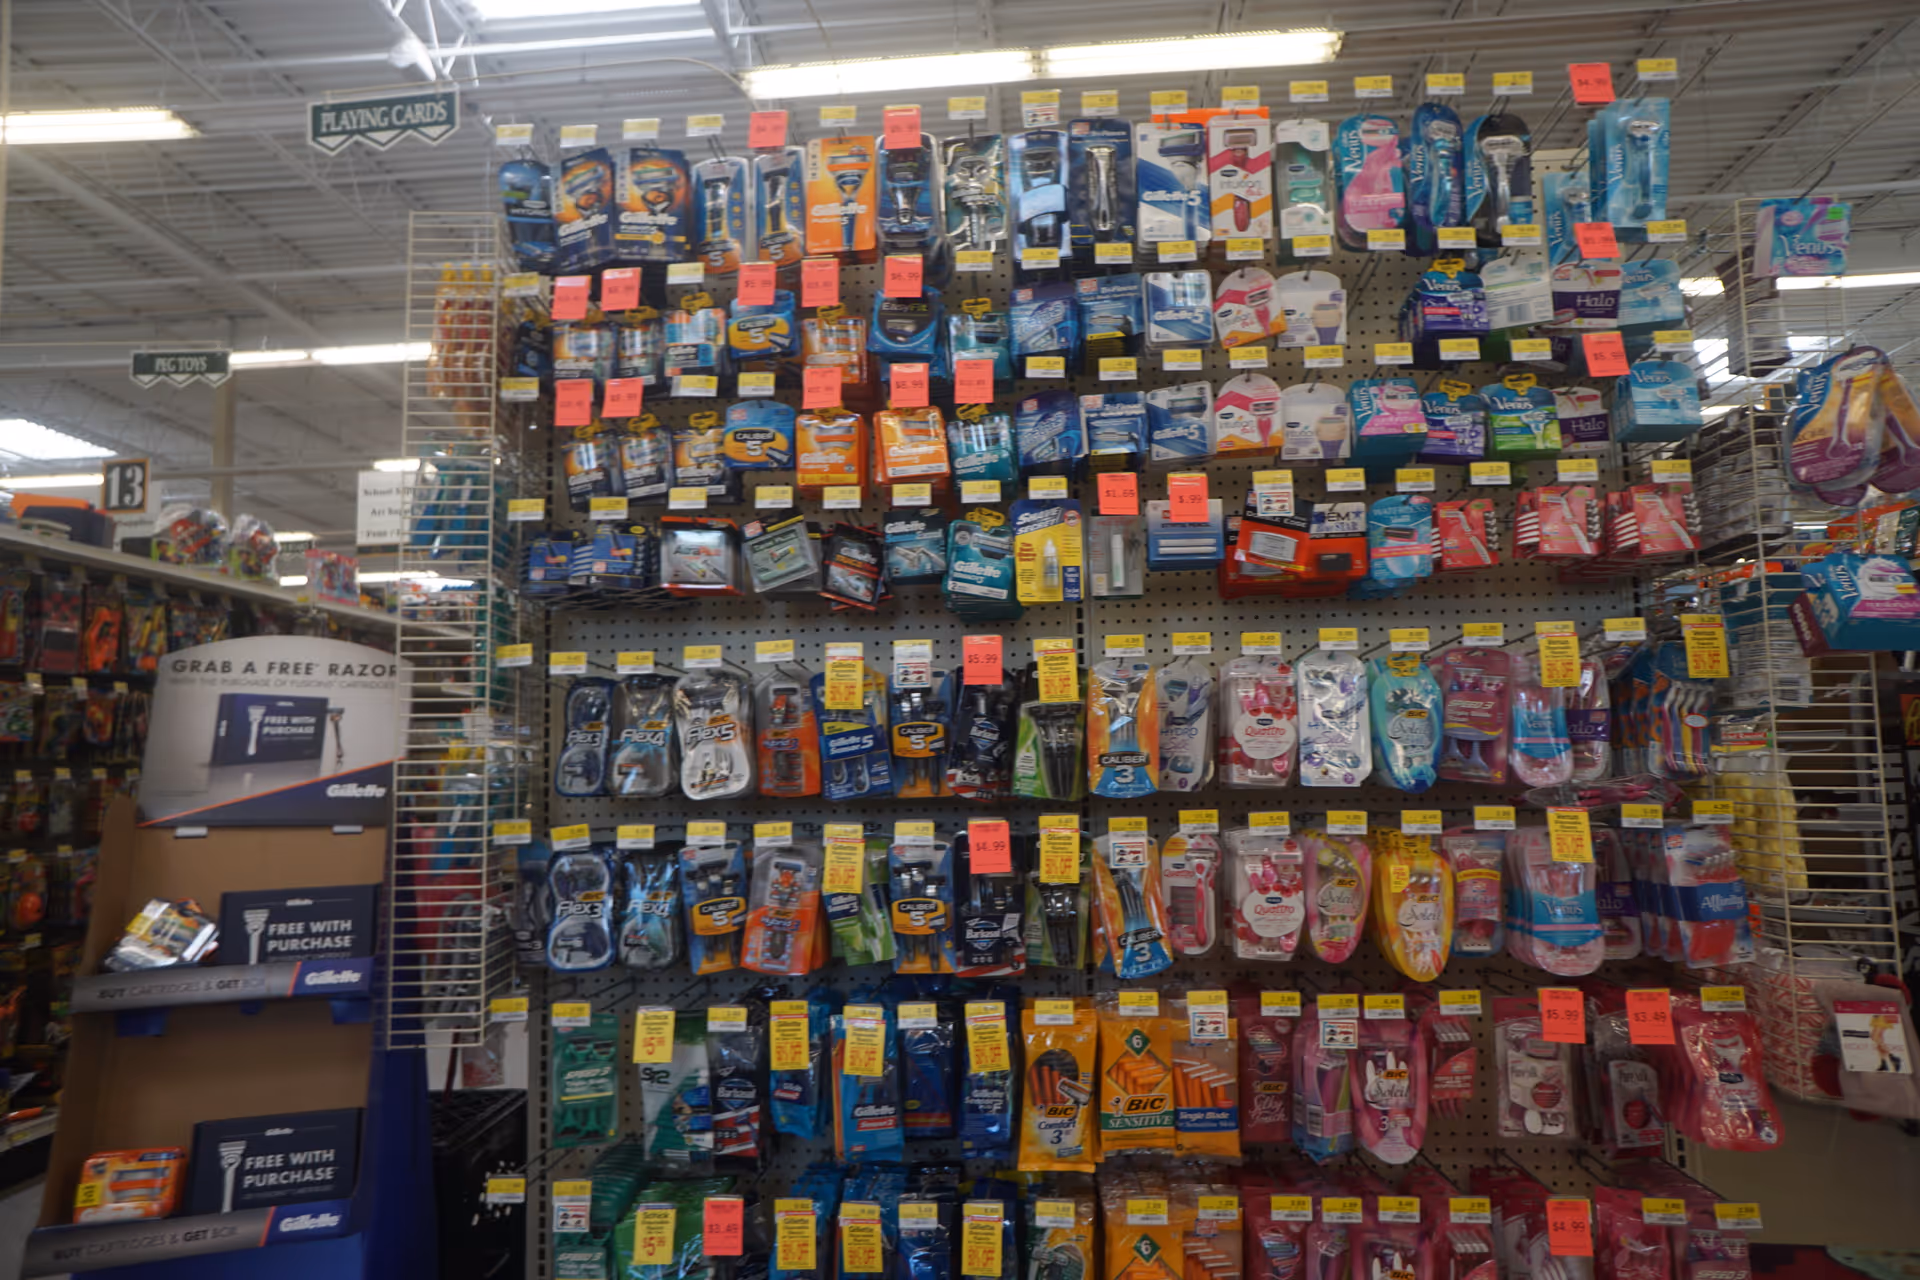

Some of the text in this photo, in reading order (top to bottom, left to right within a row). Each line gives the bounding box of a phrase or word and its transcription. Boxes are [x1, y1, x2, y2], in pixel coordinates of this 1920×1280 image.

[320, 101, 448, 133] PLAYING CARDS
[1344, 129, 1362, 173] Venus
[1411, 144, 1425, 183] Venus
[1608, 144, 1625, 184] Venus
[1467, 159, 1485, 200] Venus
[1142, 190, 1186, 202] Gillette
[811, 203, 868, 216] Gillette
[559, 213, 608, 235] Gillette
[619, 211, 678, 225] Gillette
[1780, 234, 1845, 257] Venus
[1424, 277, 1461, 291] Venus
[882, 301, 929, 313] EasyFit
[1576, 295, 1616, 307] Halo
[1154, 309, 1192, 321] Gillette
[155, 356, 207, 372] PEG TOYS
[1635, 369, 1672, 383] Venus
[1358, 386, 1373, 419] Venus
[1800, 373, 1829, 418] Venus
[1425, 400, 1461, 414] Venus
[1497, 396, 1533, 410] Venus
[1153, 426, 1187, 439] Gillette
[1571, 418, 1606, 433] Halo
[735, 431, 775, 440] CALIBER
[746, 440, 763, 456] 5
[889, 446, 935, 457] Gillette
[800, 453, 845, 464] Gillette
[954, 453, 999, 469] Gillette
[107, 464, 144, 509] 13
[885, 520, 926, 534] Gillette
[954, 560, 1001, 579] Gillette
[1836, 565, 1858, 600] Venus
[968, 654, 998, 665] $5.99
[172, 660, 232, 673] GRAB
[243, 661, 257, 674] A
[1448, 700, 1495, 709] SPEED 3
[264, 716, 316, 726] FREE WITH
[1405, 710, 1427, 718] BIC
[263, 724, 315, 735] PURCHASE
[687, 724, 736, 743] Flex5
[901, 725, 935, 735] CALIBER
[1160, 728, 1199, 738] HYDRO
[1245, 726, 1287, 738] Quattro
[567, 730, 601, 746] Flex3
[620, 729, 666, 746] Flex4
[829, 736, 860, 747] Gillette
[910, 735, 925, 750] 5
[1101, 754, 1146, 766] CALIBER
[1114, 765, 1136, 783] 3
[326, 784, 386, 799] Gillette
[1337, 879, 1357, 887] BIC
[1325, 891, 1354, 906] Soleil
[1417, 894, 1438, 902] BIC
[1701, 893, 1744, 911] Affinity
[556, 901, 604, 918] Flex3
[626, 900, 671, 918] Flex4
[702, 900, 738, 913] CALIBER
[900, 902, 935, 911] CALIBER
[1254, 904, 1295, 915] Quattro
[1545, 900, 1584, 915] Venus
[712, 911, 729, 926] 5
[910, 911, 926, 927] 5
[1404, 906, 1442, 922] Soleil
[268, 920, 353, 936] FREE WITH
[966, 929, 1001, 939] Barbasol
[266, 936, 354, 952] PURCHASE
[1118, 930, 1161, 948] CALIBER
[1135, 943, 1152, 960] 3
[304, 969, 362, 986] Gillette
[99, 986, 125, 998] BUY
[216, 979, 241, 990] GET
[1546, 1008, 1580, 1022] $5.99
[1132, 1036, 1143, 1048] 6
[565, 1067, 611, 1079] SPEED 3
[1385, 1070, 1407, 1079] BIC
[717, 1086, 756, 1099] Barbasol
[1262, 1082, 1285, 1092] BIC
[1373, 1080, 1410, 1099] Soleil
[854, 1104, 896, 1118] Gillette
[1046, 1105, 1077, 1117] BIC
[1126, 1097, 1165, 1111] BIC
[1109, 1114, 1173, 1129] SENSITIVE
[1179, 1111, 1230, 1121] Single Blade
[1038, 1119, 1077, 1130] Comfort
[1379, 1116, 1388, 1131] 3
[1050, 1130, 1063, 1145] 3
[245, 1149, 335, 1170] FREE WITH
[242, 1167, 336, 1188] PURCHASE
[279, 1214, 340, 1233] Gillette
[86, 1235, 164, 1257] CARTRIDGES
[182, 1228, 209, 1242] GET
[1141, 1241, 1151, 1254] 6
[558, 1252, 593, 1262] SPEED
[1697, 1270, 1733, 1280] SPEED
